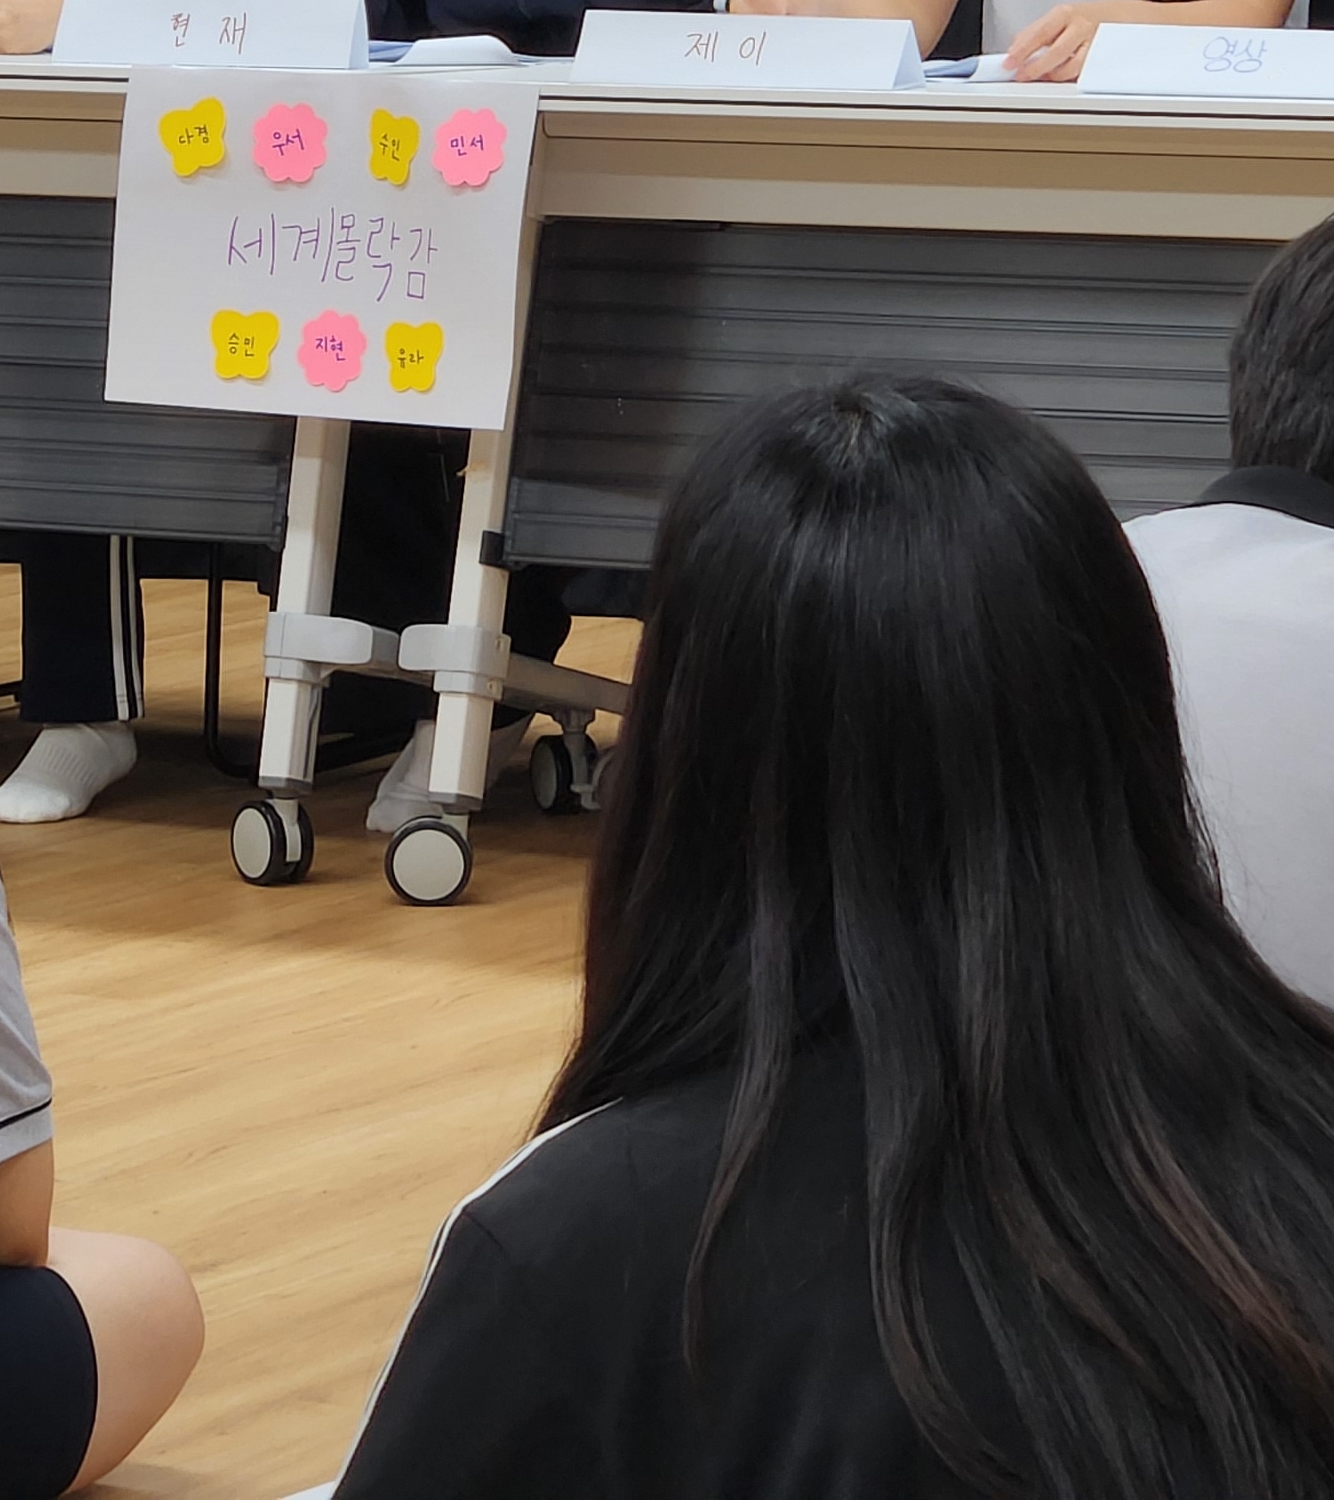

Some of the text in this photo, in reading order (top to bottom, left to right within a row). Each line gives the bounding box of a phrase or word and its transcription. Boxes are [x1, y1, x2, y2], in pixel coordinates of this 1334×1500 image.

[1202, 36, 1268, 74] 영상
[178, 123, 210, 145] 다경
[271, 129, 305, 156] 우서
[379, 132, 401, 162] 수인
[450, 134, 485, 157] 민서
[227, 207, 439, 302] 세계몰락감
[228, 332, 255, 357] 승민
[315, 336, 346, 362] 지현
[397, 347, 425, 369] 유라
